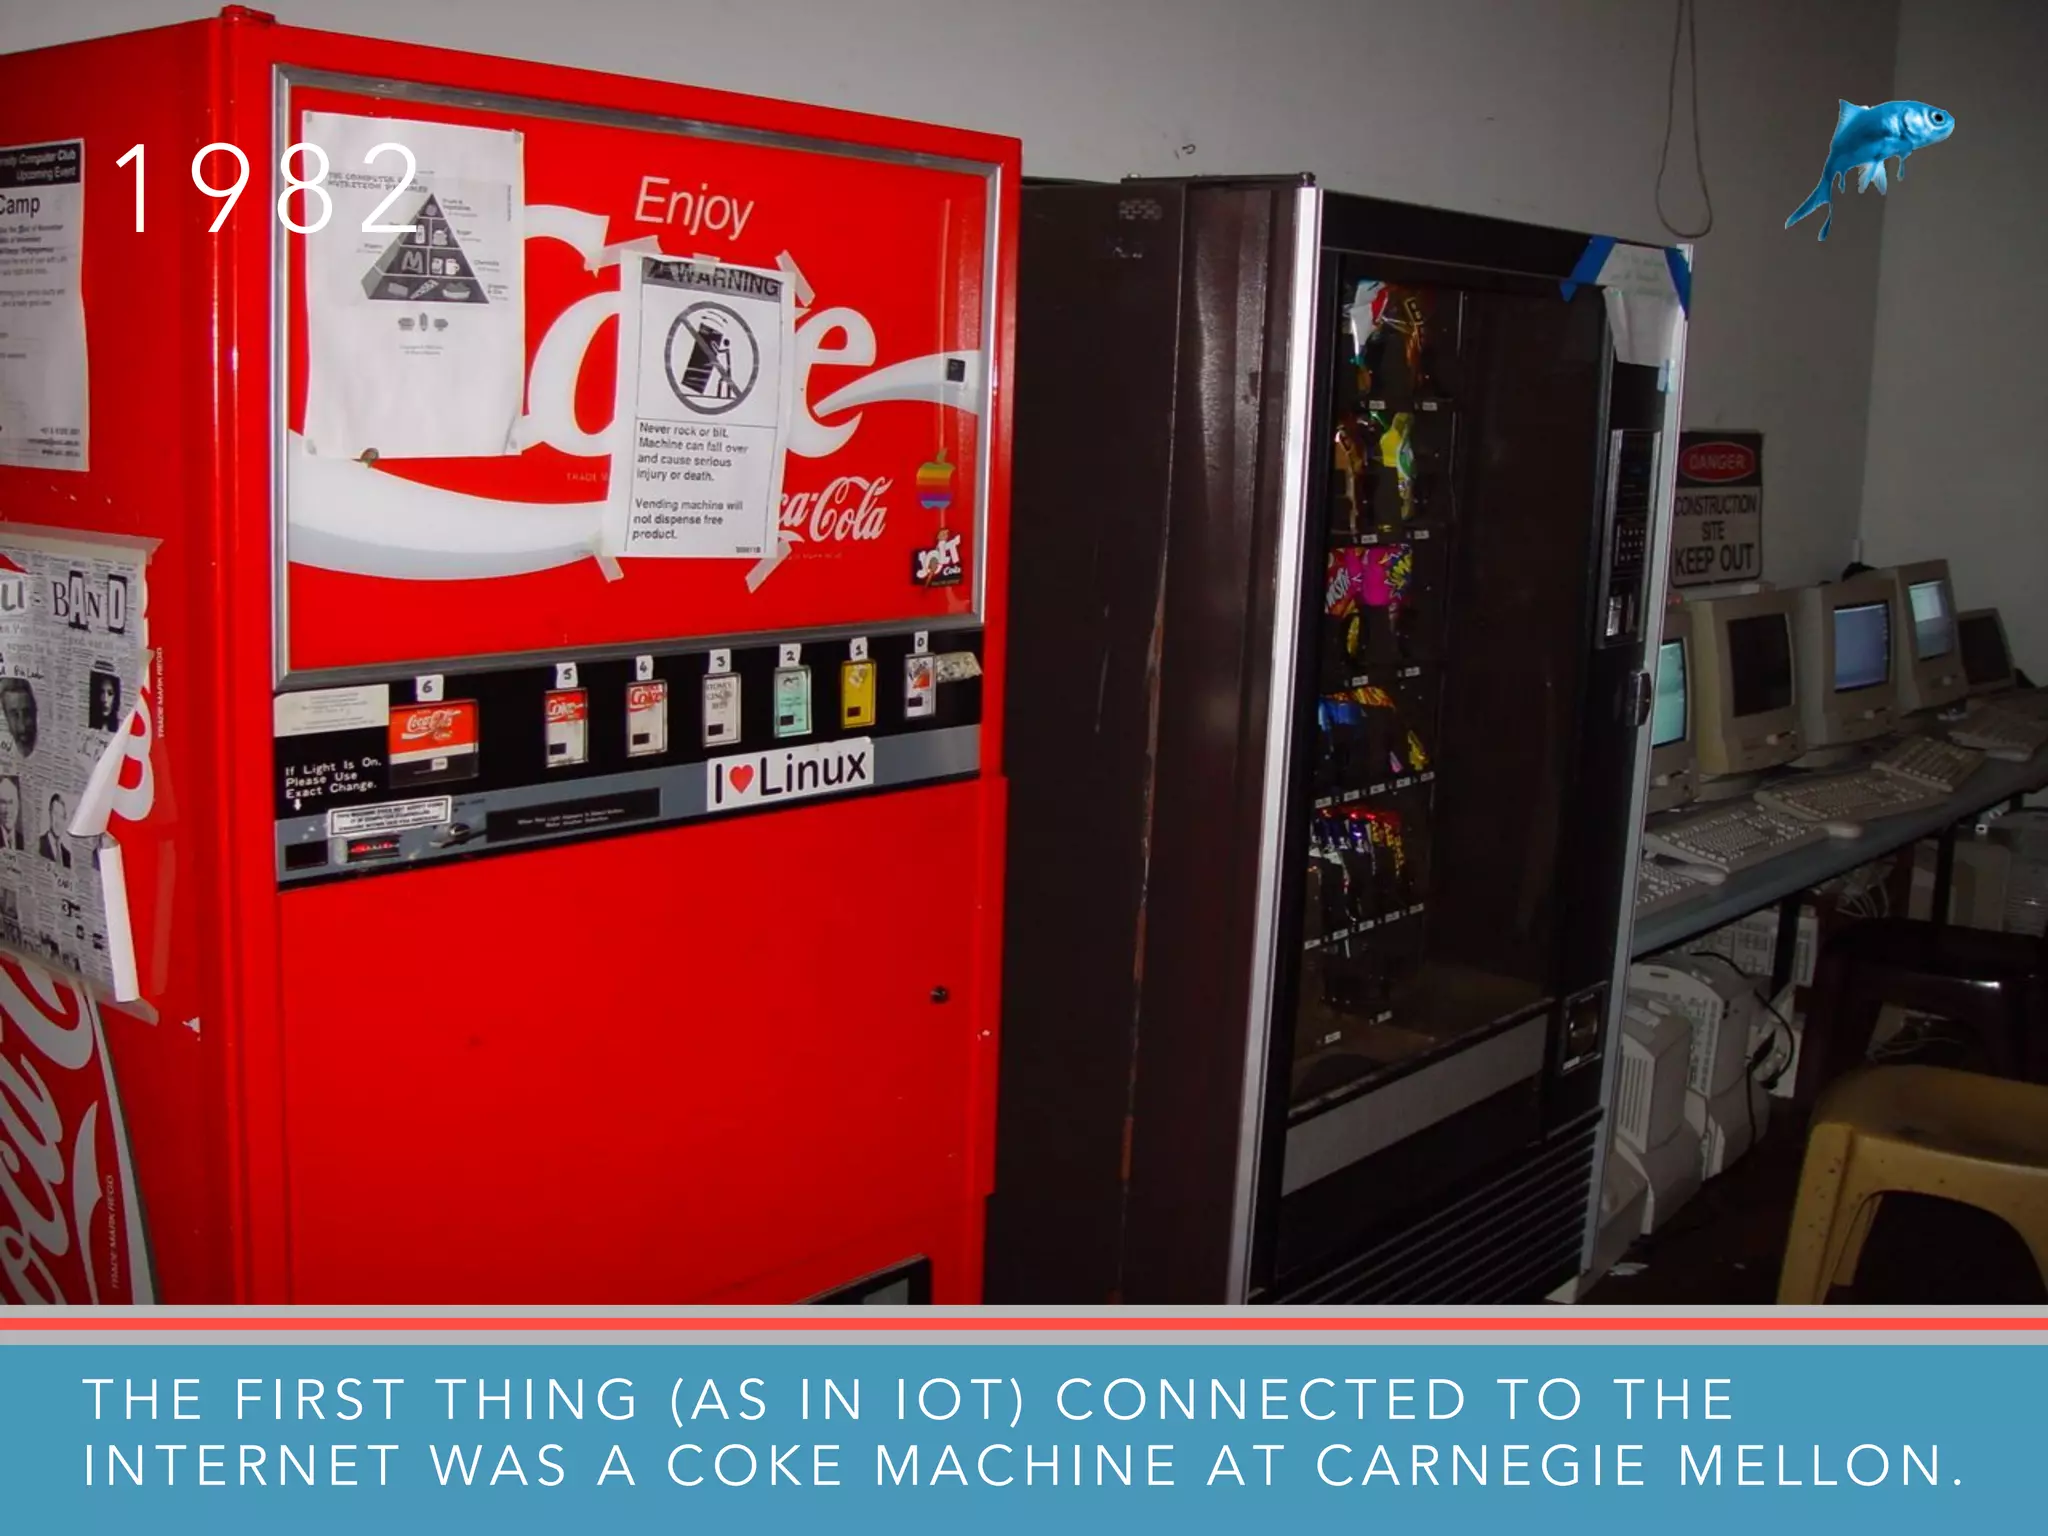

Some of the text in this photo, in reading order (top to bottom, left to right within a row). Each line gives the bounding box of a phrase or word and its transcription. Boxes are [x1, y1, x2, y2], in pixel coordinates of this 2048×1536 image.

[56, 148, 77, 161] Club
[634, 175, 754, 241] Enjoy
[677, 261, 779, 297] WARNING
[639, 422, 671, 435] Never
[673, 424, 697, 436] rock
[699, 427, 710, 437] or
[639, 437, 749, 454] Machine can fall over
[637, 453, 732, 467] and cause serious
[1689, 453, 1747, 470] DANGER
[636, 469, 715, 481] injury or death.
[635, 498, 743, 512] Vending machine will
[1674, 494, 1757, 517] CONSTRUCTION
[633, 514, 723, 526] not dispense free
[632, 529, 678, 541] product.
[1701, 520, 1725, 541] SITE
[1674, 542, 1754, 576] KEEP OUT
[52, 570, 128, 635] BAND
[716, 656, 726, 667] 3
[786, 650, 795, 661] 2
[563, 667, 572, 680] 5
[639, 661, 647, 673] 4
[422, 680, 432, 693] 6
[285, 766, 296, 776] If
[303, 762, 336, 776] Light
[343, 760, 355, 770] Is
[285, 772, 358, 787] Please Use
[715, 750, 867, 804] I Linux
[285, 781, 377, 799] Exact Change.
[107, 1211, 117, 1249] MARK
